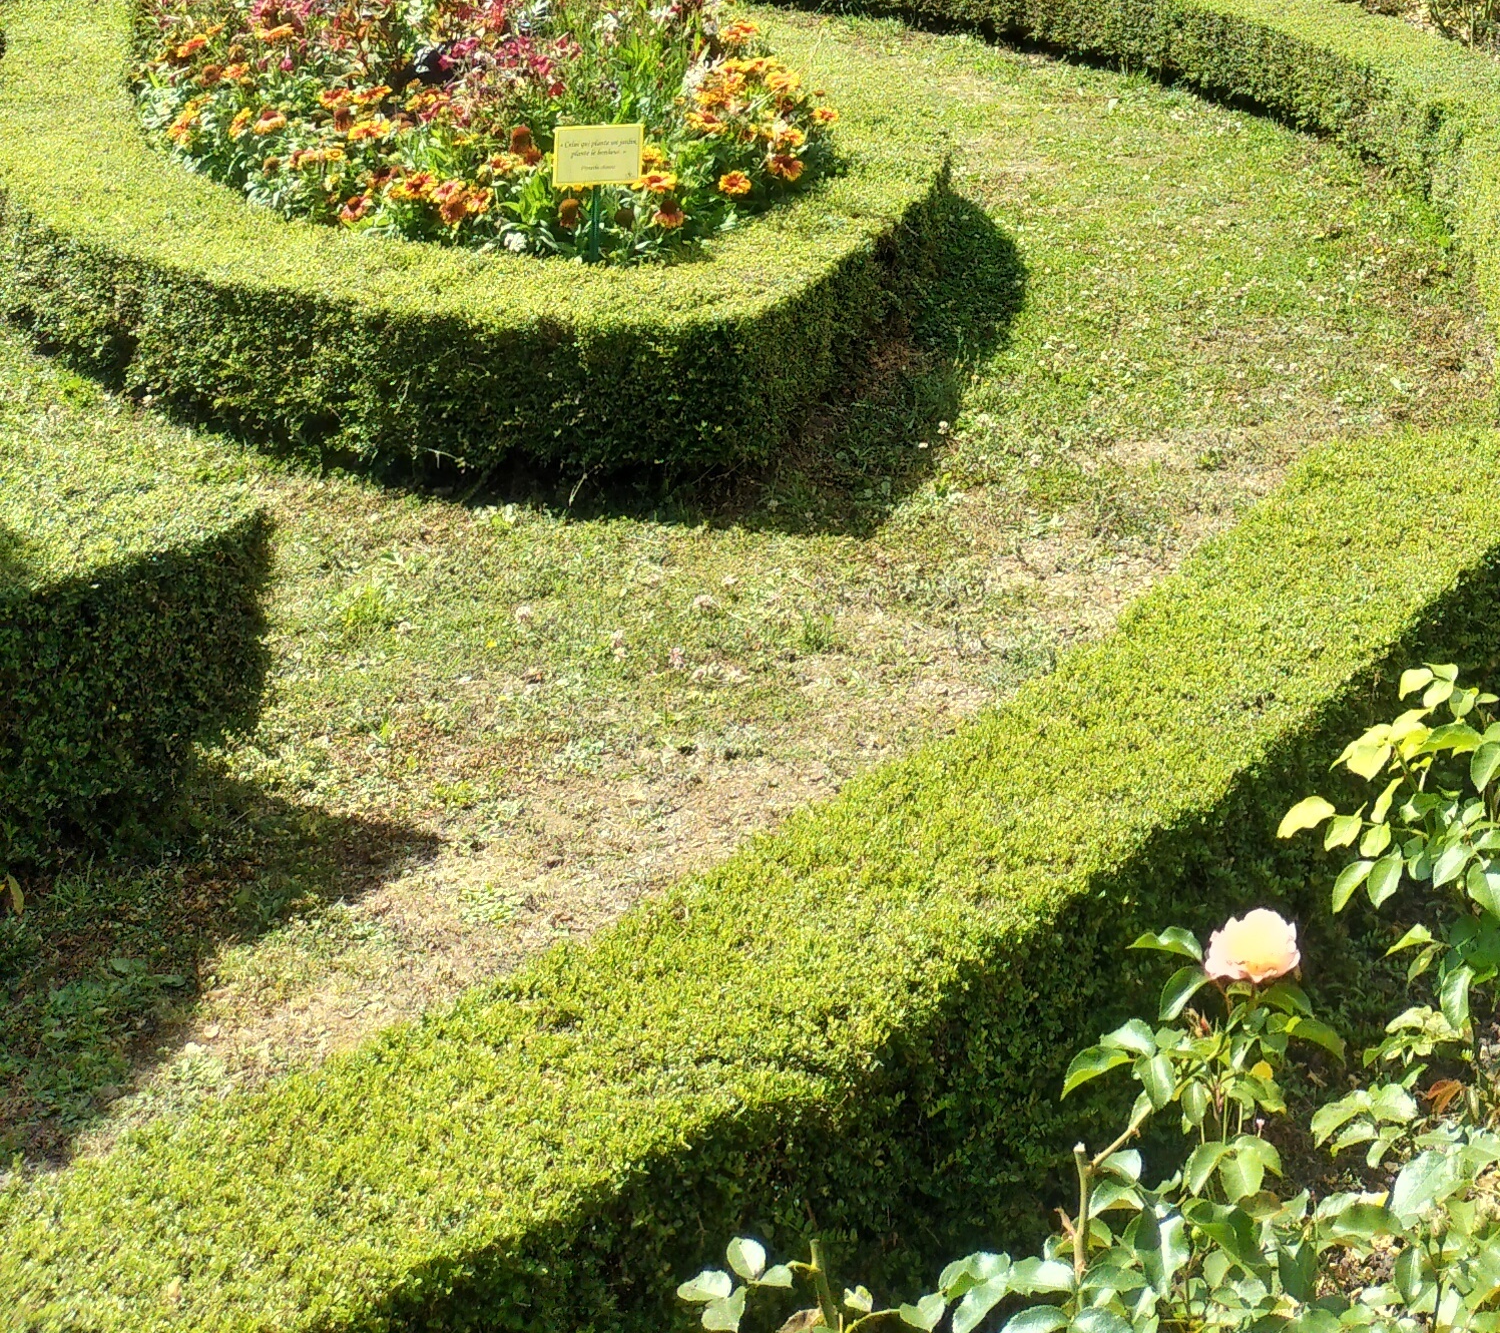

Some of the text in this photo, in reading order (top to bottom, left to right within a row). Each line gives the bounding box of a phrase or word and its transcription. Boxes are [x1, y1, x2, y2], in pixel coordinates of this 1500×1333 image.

[581, 141, 589, 149] qui
[591, 139, 609, 148] plante
[571, 149, 589, 159] plante
